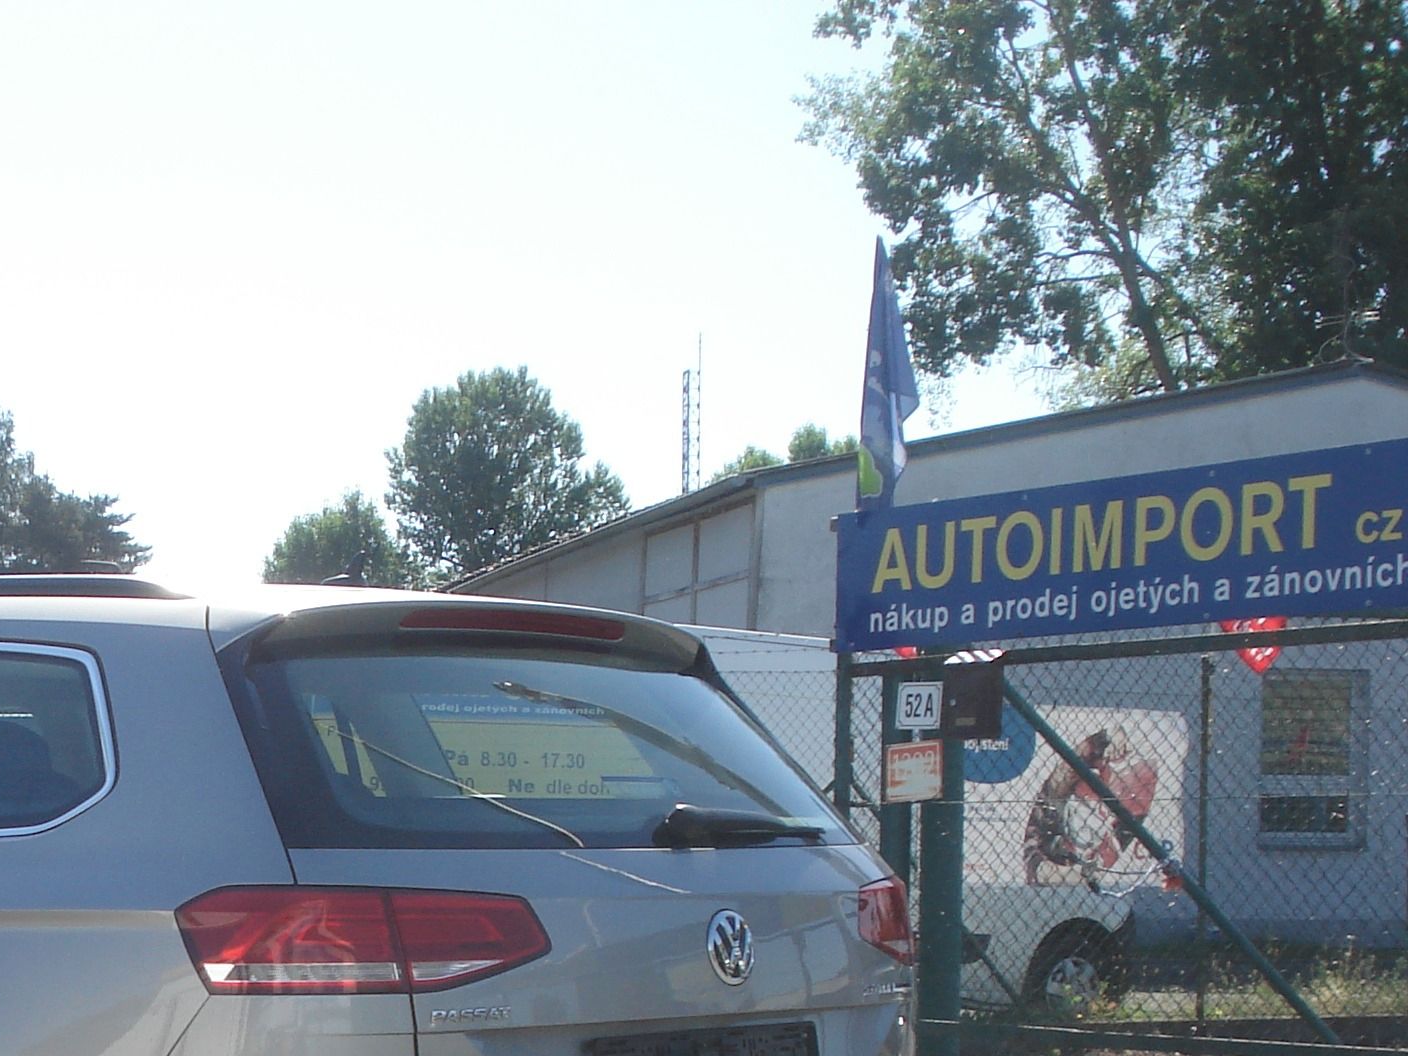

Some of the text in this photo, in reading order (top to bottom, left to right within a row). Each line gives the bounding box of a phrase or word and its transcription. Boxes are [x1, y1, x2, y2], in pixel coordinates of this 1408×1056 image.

[872, 473, 1403, 594] AUTOIMPORT cz
[869, 603, 949, 634] nákup
[961, 603, 975, 625] a
[988, 585, 1078, 628] prodej
[1091, 574, 1200, 618] ojetých
[1214, 577, 1231, 602] a
[480, 751, 517, 767] 8.30
[541, 752, 585, 769] 17.30
[508, 778, 535, 794] Ne
[546, 780, 573, 794] dle
